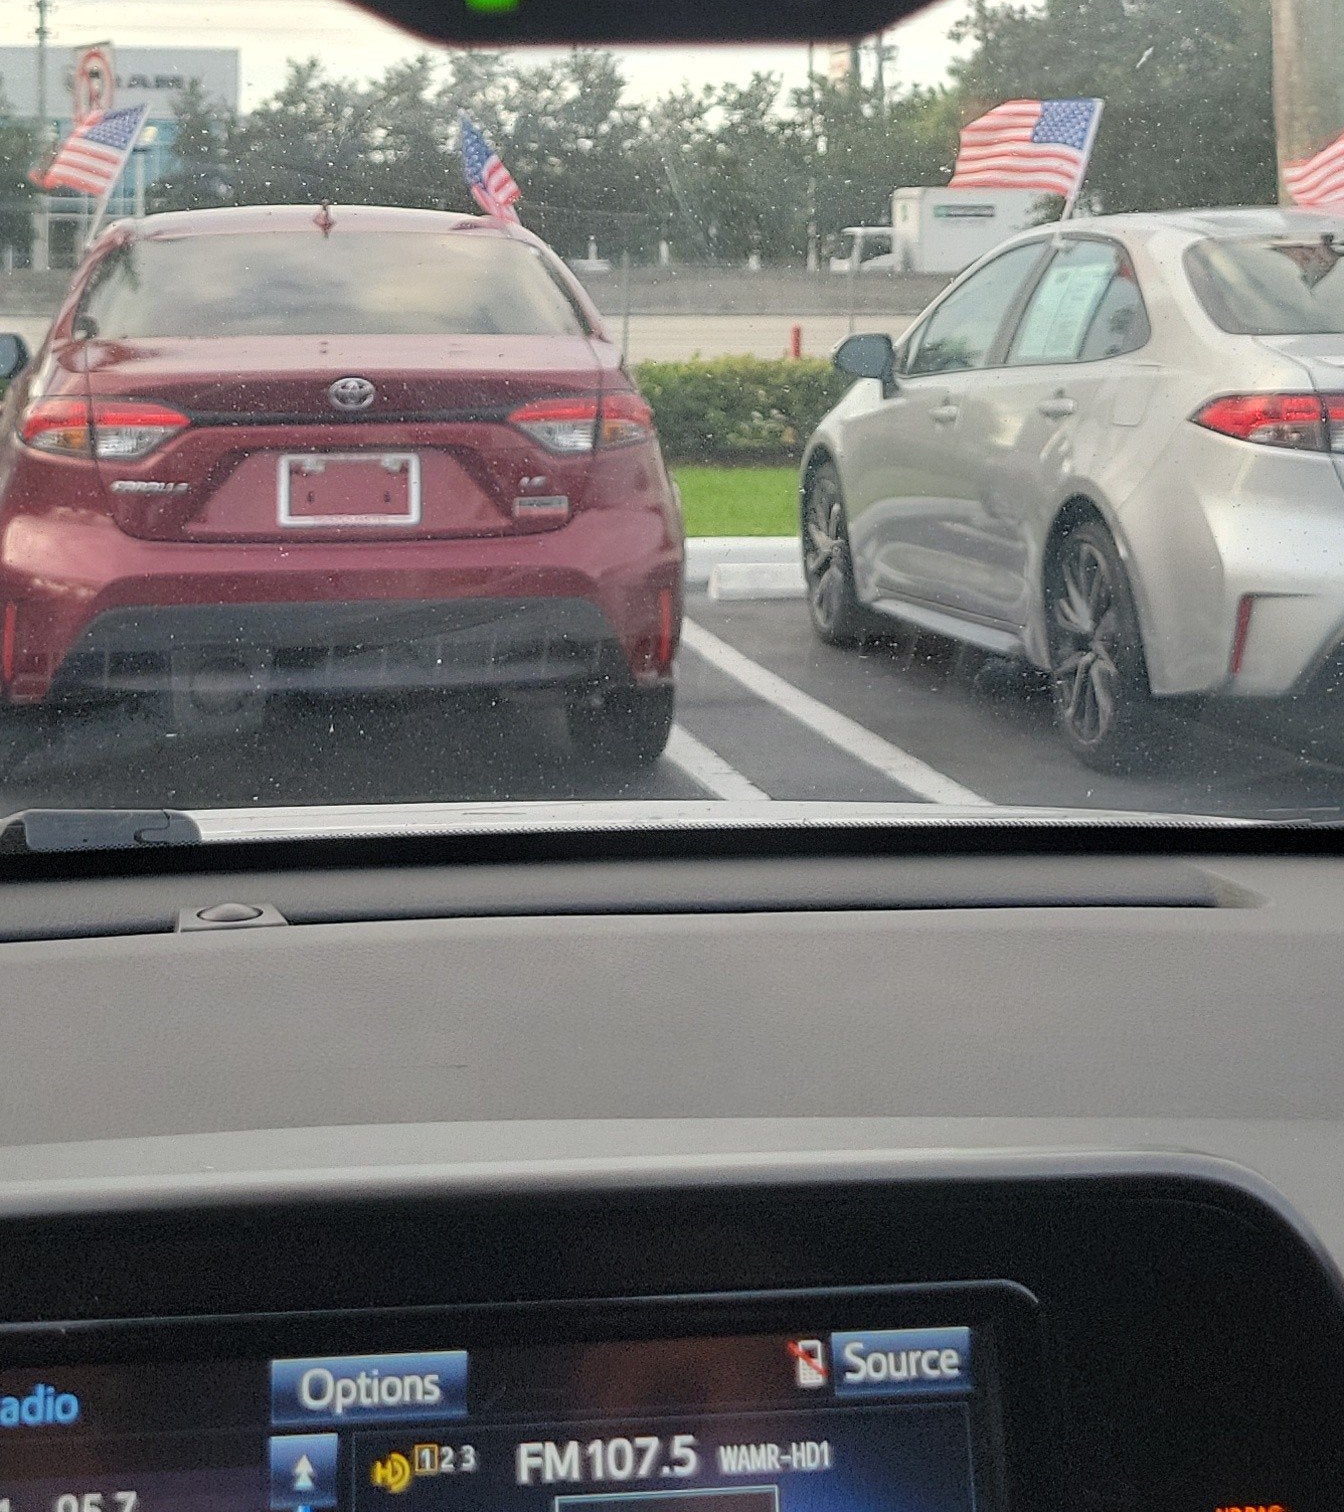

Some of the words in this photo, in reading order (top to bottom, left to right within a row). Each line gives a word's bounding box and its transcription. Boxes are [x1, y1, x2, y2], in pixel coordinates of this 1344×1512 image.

[843, 1341, 961, 1382] Source
[300, 1368, 443, 1415] Options
[441, 1445, 455, 1471] 2
[460, 1444, 477, 1471] 3
[719, 1440, 832, 1474] WAMR-HD1
